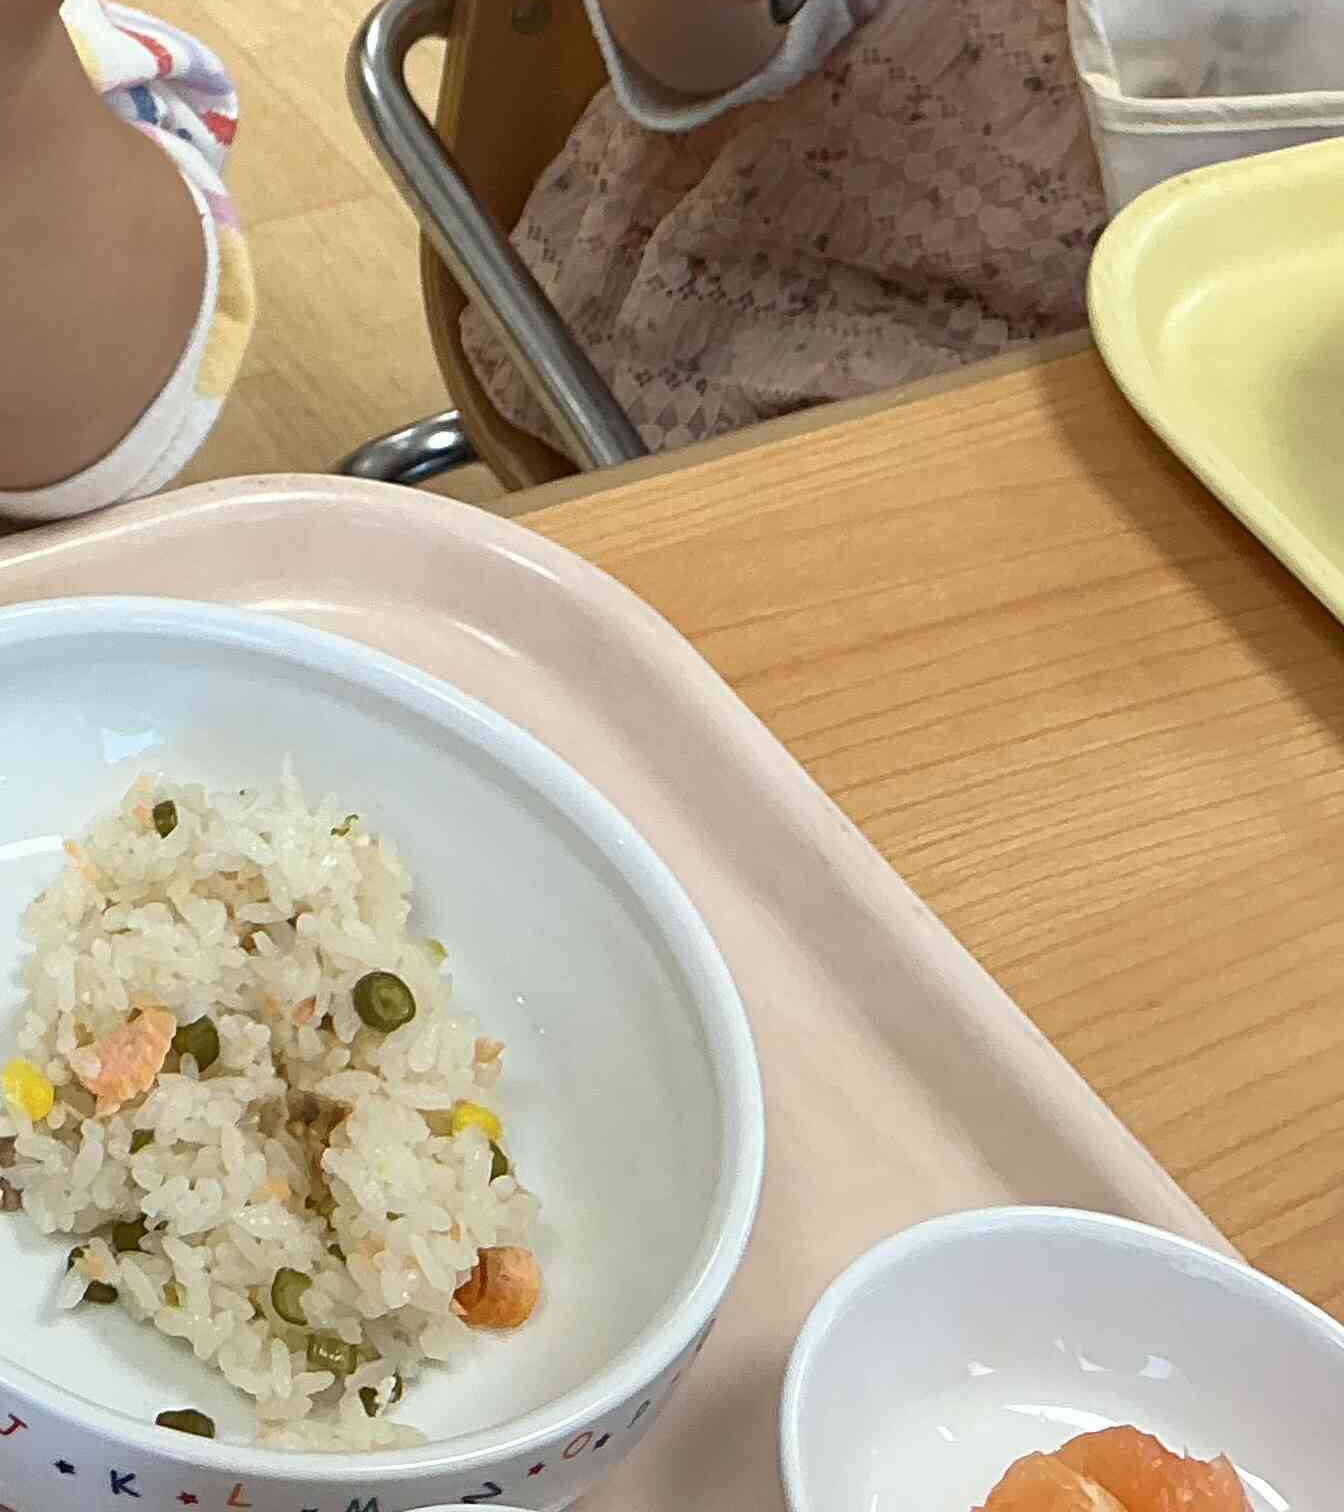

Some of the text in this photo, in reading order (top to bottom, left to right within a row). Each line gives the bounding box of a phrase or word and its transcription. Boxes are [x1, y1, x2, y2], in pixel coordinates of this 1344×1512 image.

[110, 1470, 142, 1498] K
[227, 1483, 254, 1507] L
[345, 1496, 380, 1512] M
[562, 1431, 593, 1460] O
